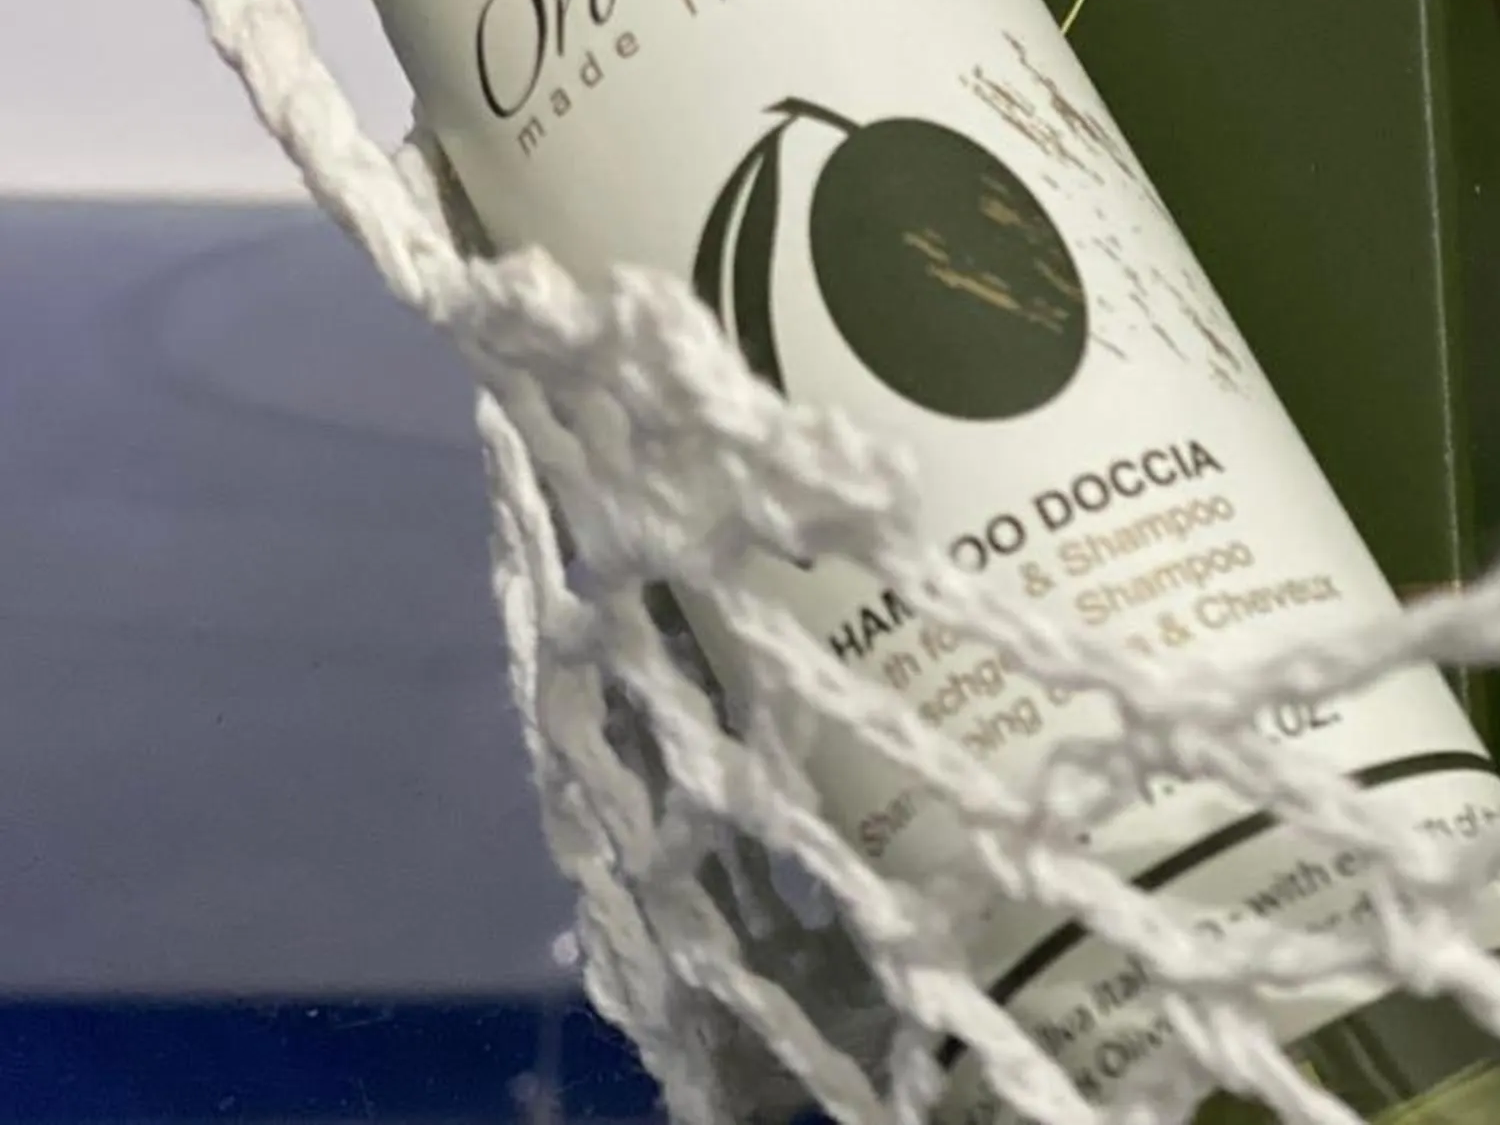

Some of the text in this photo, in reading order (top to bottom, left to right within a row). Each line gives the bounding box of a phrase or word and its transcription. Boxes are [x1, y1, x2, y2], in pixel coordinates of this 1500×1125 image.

[517, 29, 642, 158] made
[1033, 438, 1226, 533] DOCCIA
[1018, 560, 1057, 599] &
[1056, 494, 1237, 578] Shampoo
[1074, 539, 1256, 627] Shampoo
[1156, 610, 1195, 649] &
[1244, 859, 1333, 918] with
